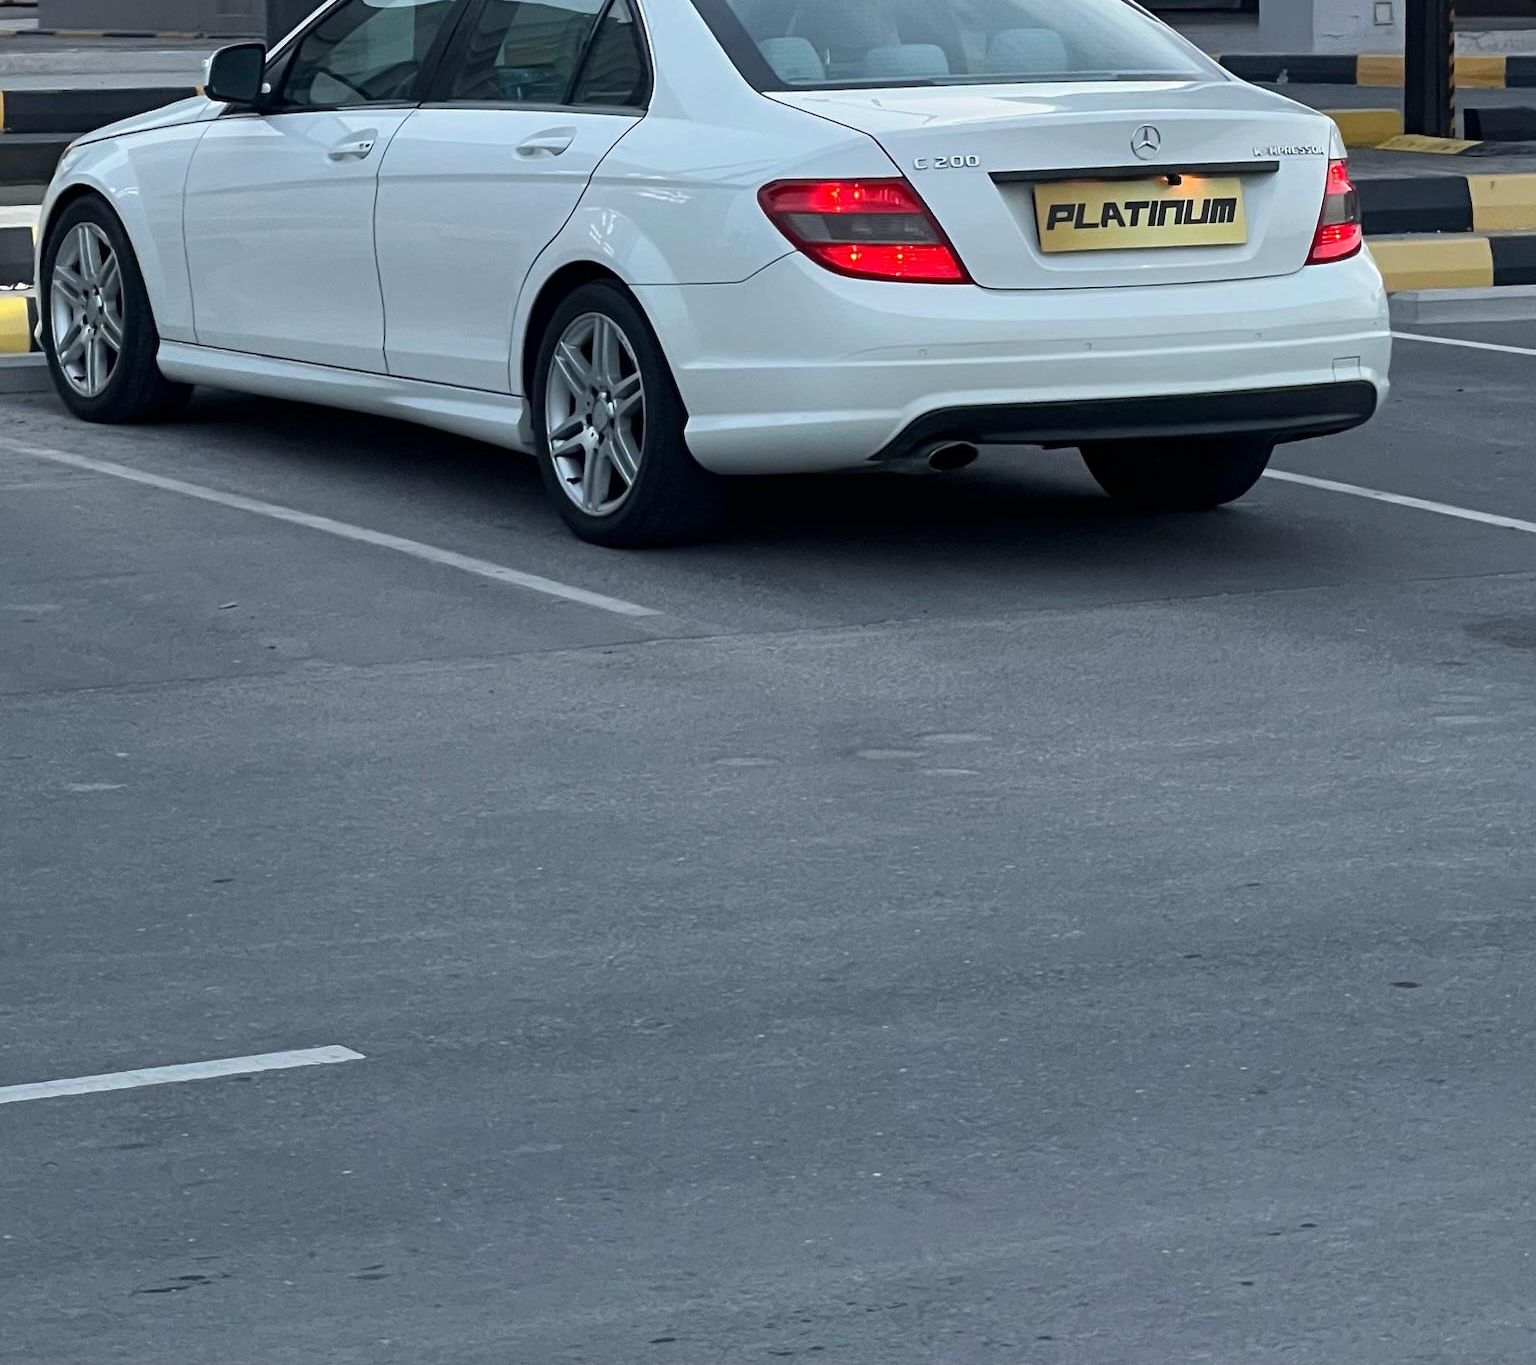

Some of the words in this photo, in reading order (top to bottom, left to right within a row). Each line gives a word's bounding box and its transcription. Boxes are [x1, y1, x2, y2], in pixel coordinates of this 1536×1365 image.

[913, 157, 928, 170] C
[934, 154, 980, 169] 200
[1046, 197, 1237, 230] PLATINUM
